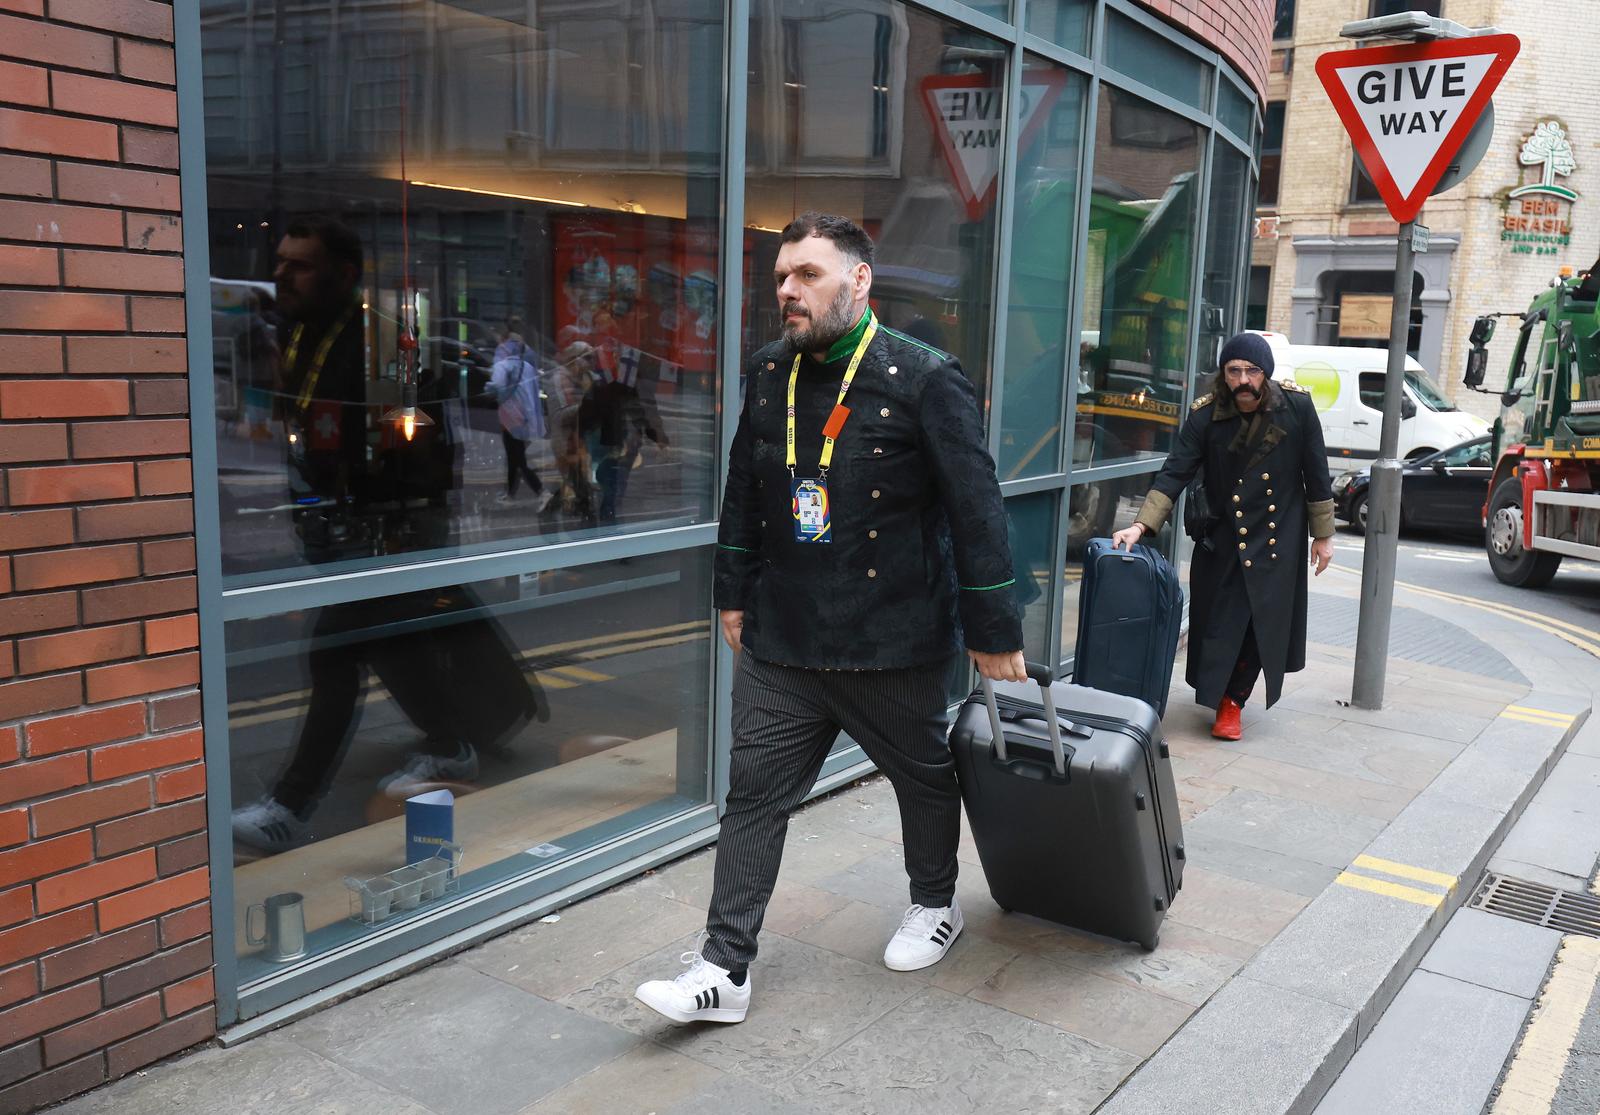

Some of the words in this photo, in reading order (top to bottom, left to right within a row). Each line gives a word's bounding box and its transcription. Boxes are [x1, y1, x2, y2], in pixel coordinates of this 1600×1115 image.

[1357, 63, 1465, 104] GIVE
[1380, 110, 1447, 135] WAY
[1522, 200, 1559, 215] BEM
[1504, 217, 1570, 234] BRASIL
[1501, 232, 1569, 246] STEAKHOUSE
[1511, 245, 1533, 254] AND
[1536, 247, 1557, 255] BAR
